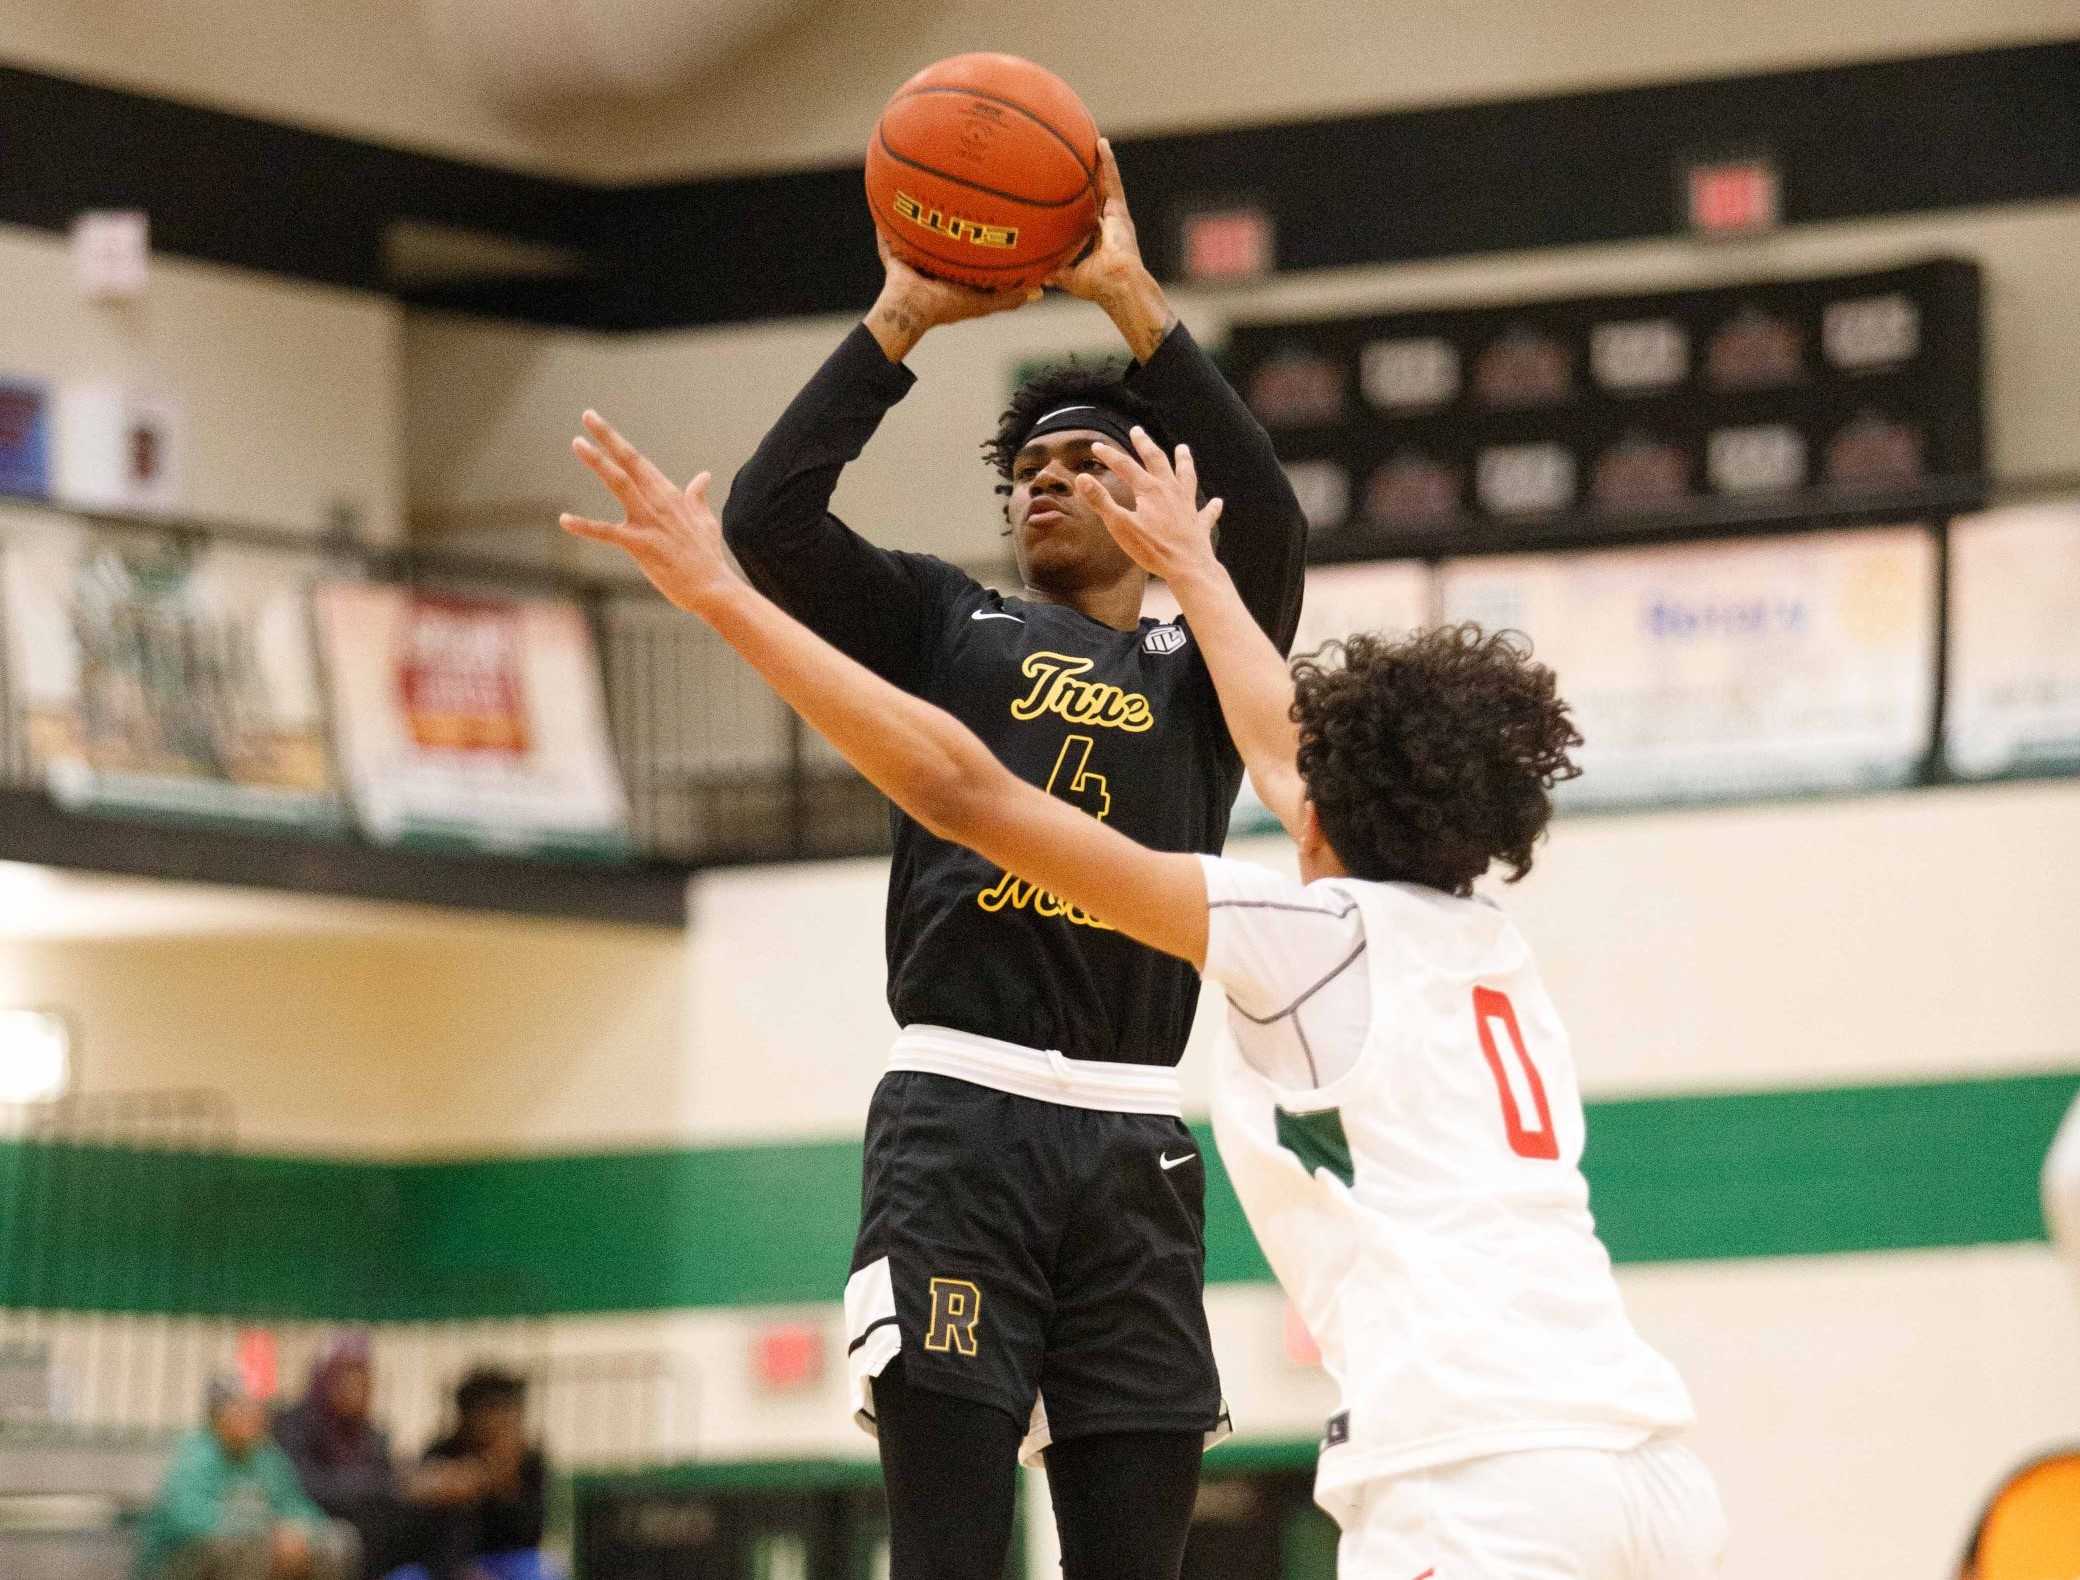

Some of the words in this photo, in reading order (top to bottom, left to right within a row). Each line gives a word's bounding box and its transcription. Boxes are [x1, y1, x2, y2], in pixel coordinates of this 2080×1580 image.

[893, 189, 1019, 249] ELITE
[1010, 651, 1154, 733] True
[1046, 734, 1111, 822] 4
[1472, 985, 1560, 1161] 0
[924, 1277, 981, 1356] R
